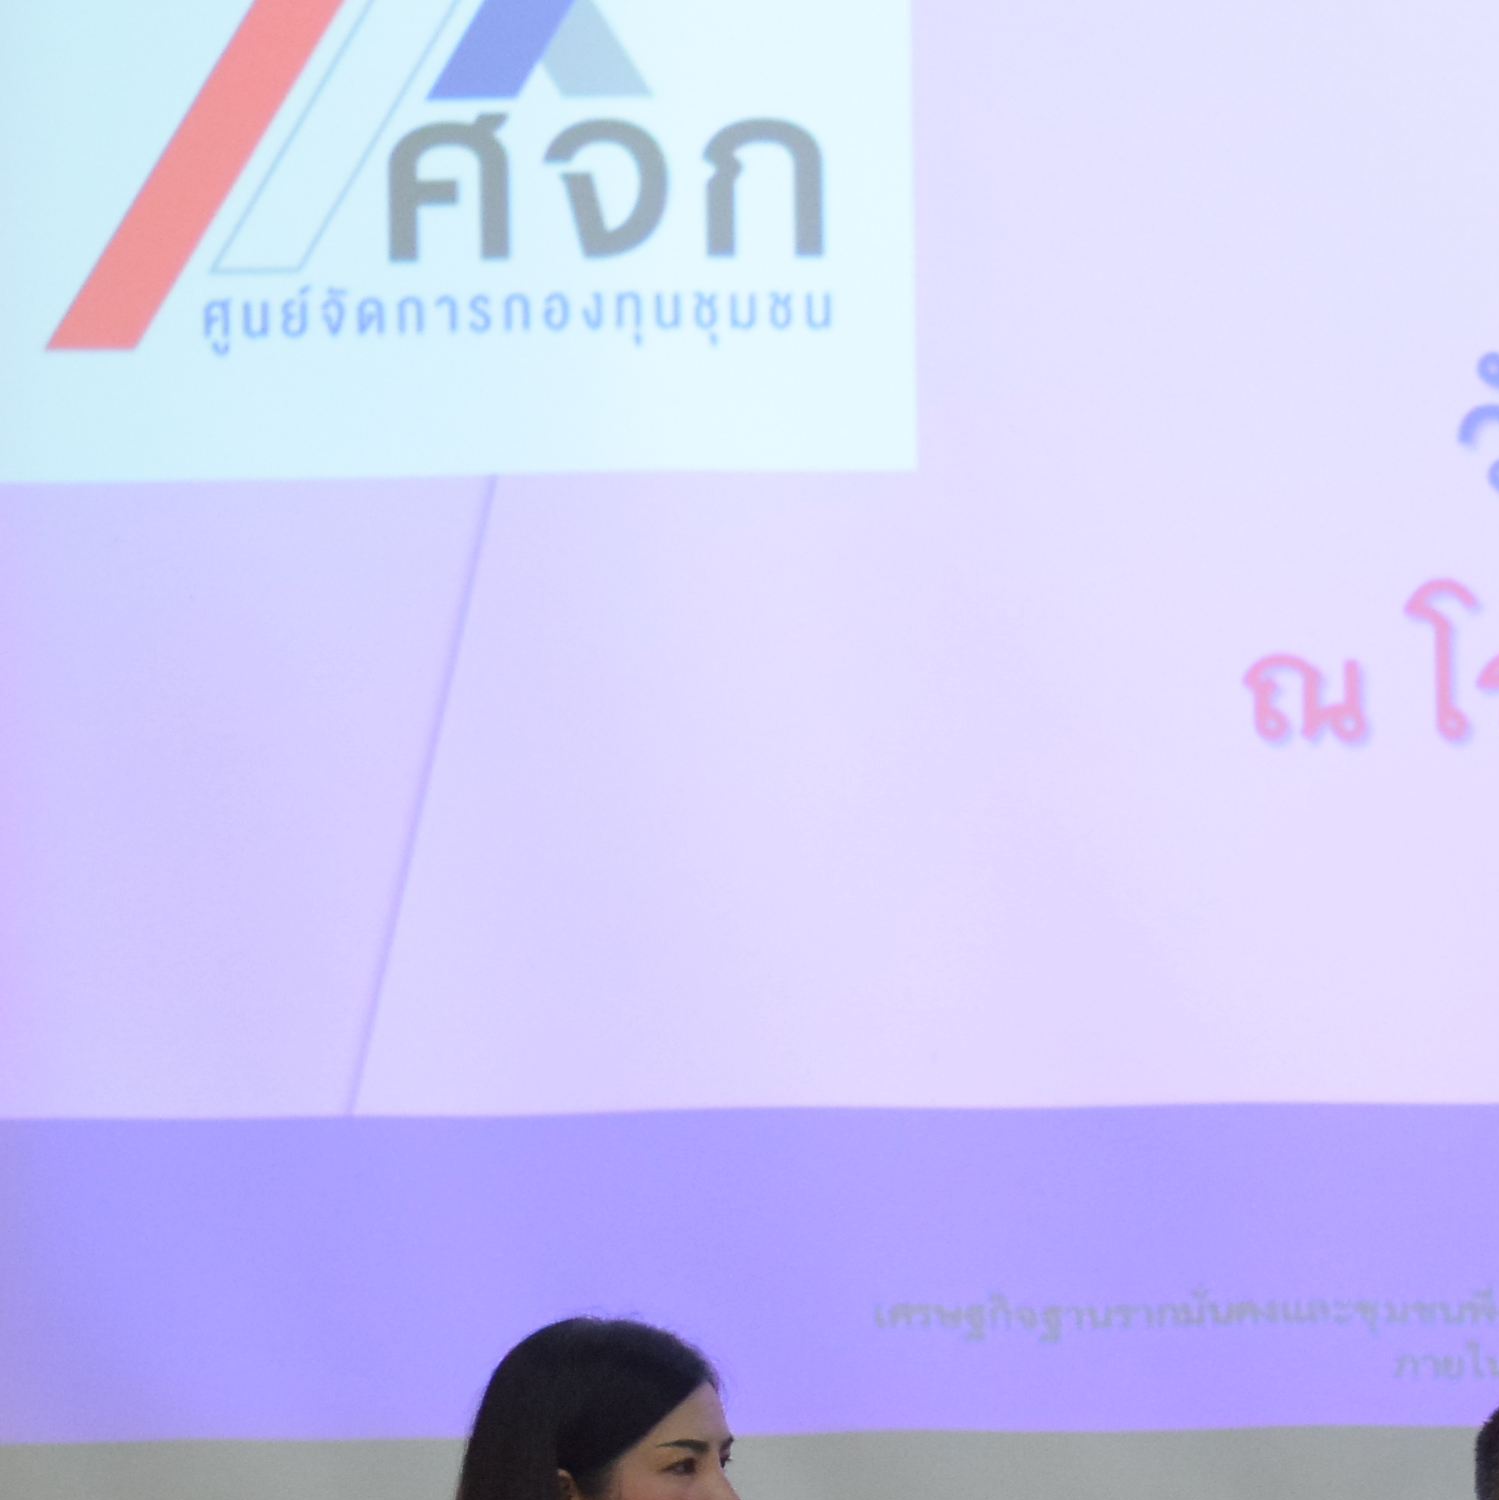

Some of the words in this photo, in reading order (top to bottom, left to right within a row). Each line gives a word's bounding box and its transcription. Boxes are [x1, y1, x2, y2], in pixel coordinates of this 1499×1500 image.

[387, 112, 825, 264] ศจก
[202, 285, 833, 358] ศูนย์จัดการกองทุนชุมชน
[1242, 652, 1370, 744] ณ
